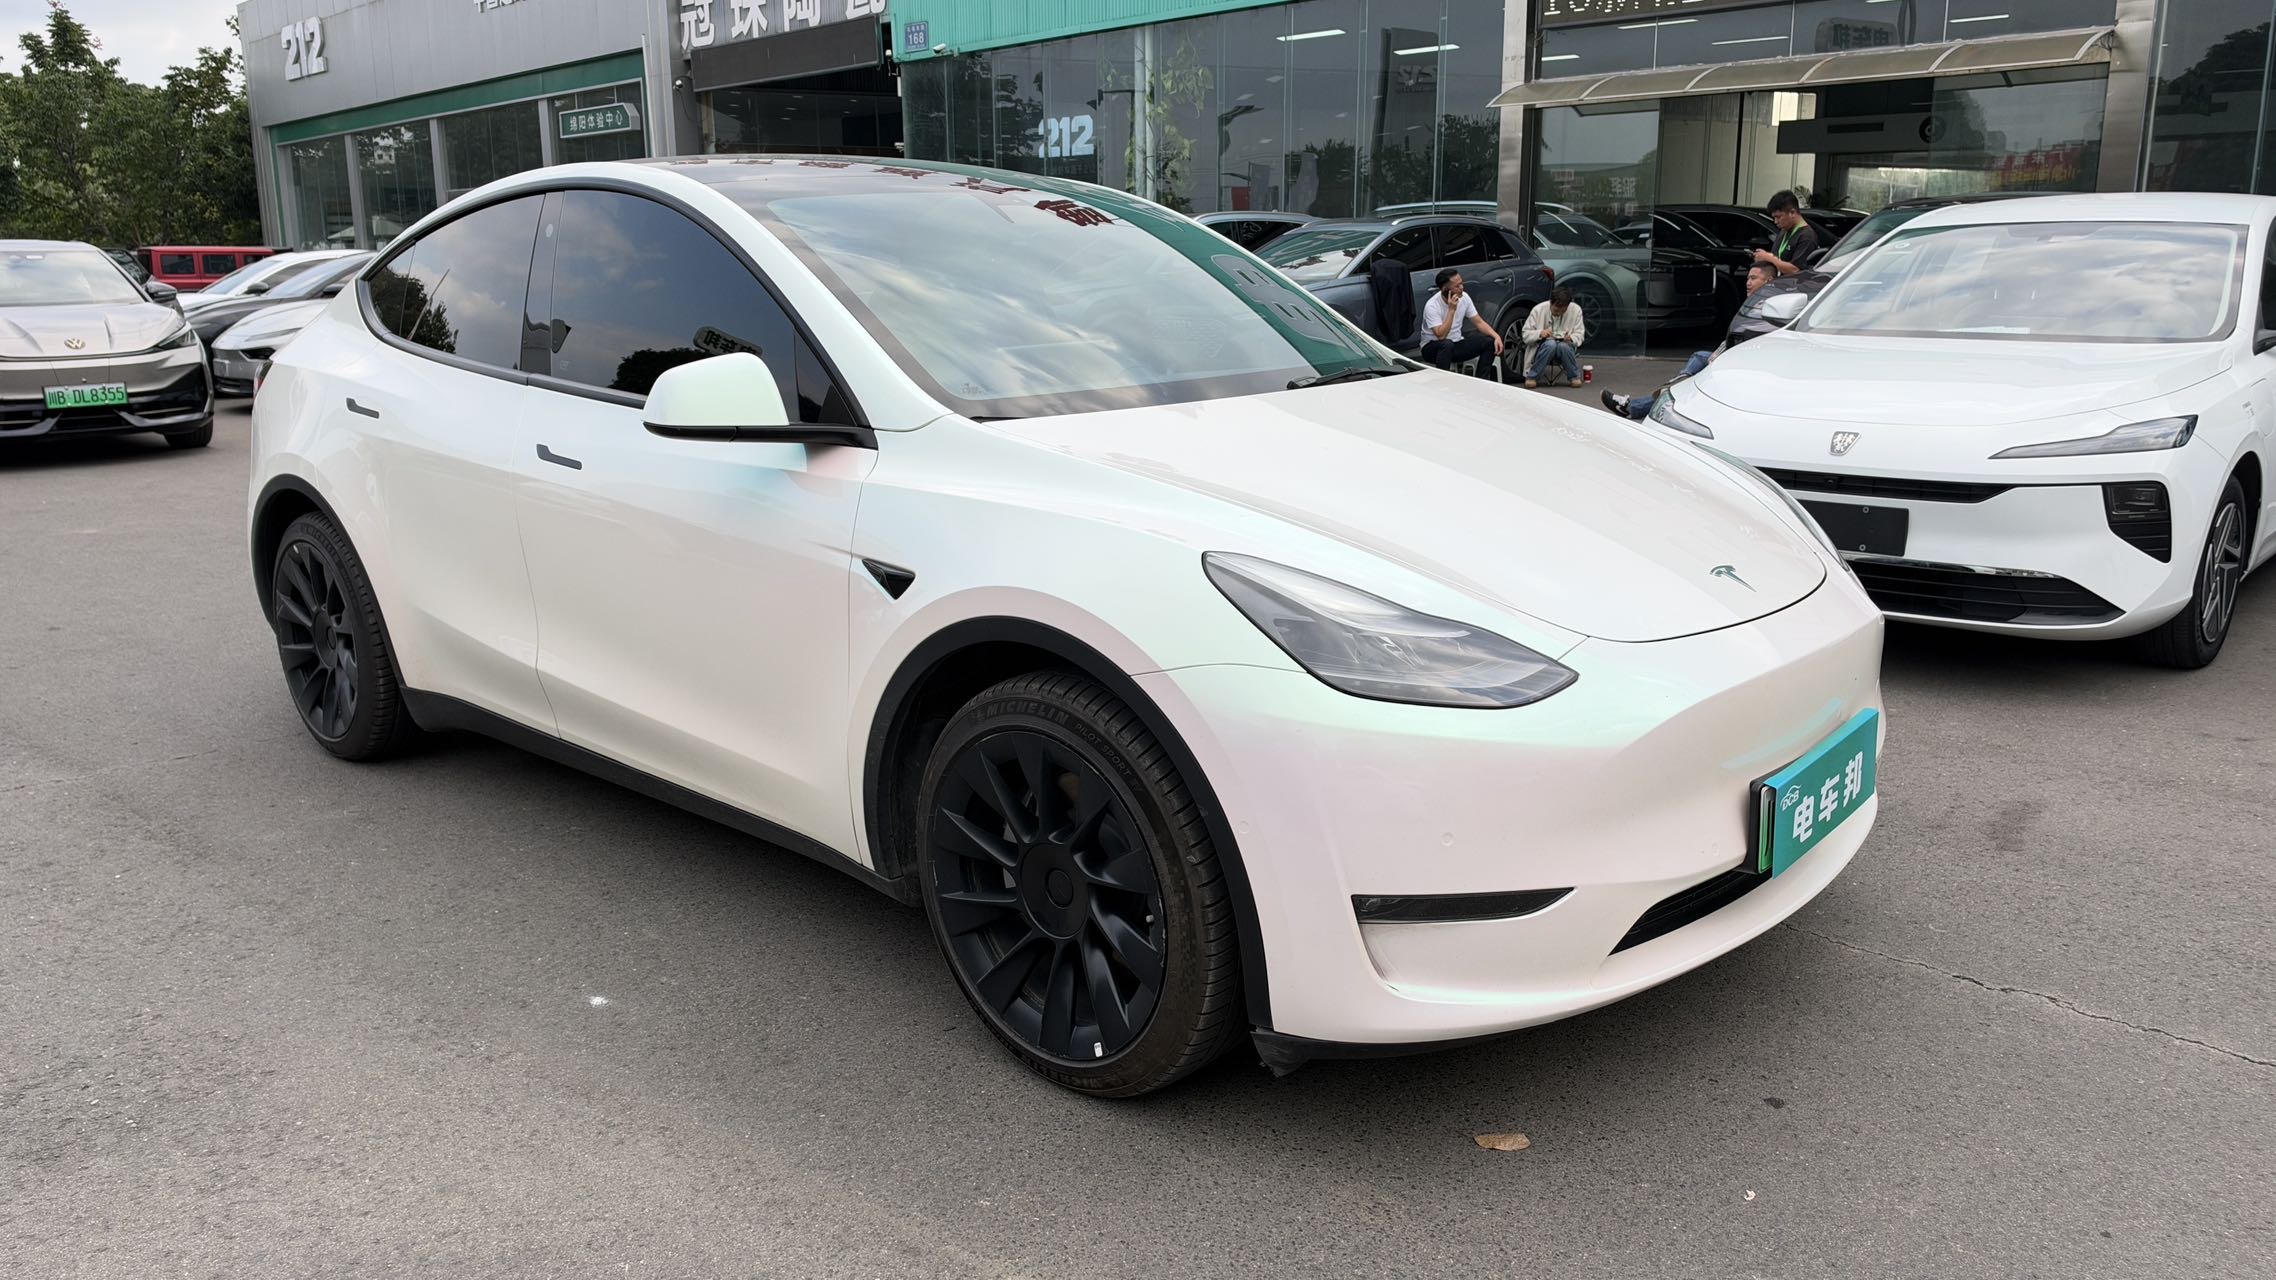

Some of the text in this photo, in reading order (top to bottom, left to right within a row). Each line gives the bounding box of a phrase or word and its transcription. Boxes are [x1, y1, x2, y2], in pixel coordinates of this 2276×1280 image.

[281, 16, 327, 81] 212
[908, 32, 925, 45] 168
[569, 110, 623, 131] 绵阳体验中心
[1038, 114, 1095, 158] 212
[987, 700, 1071, 727] MICHELIN
[1102, 745, 1133, 777] SPORT
[1793, 751, 1863, 843] 电车邦
